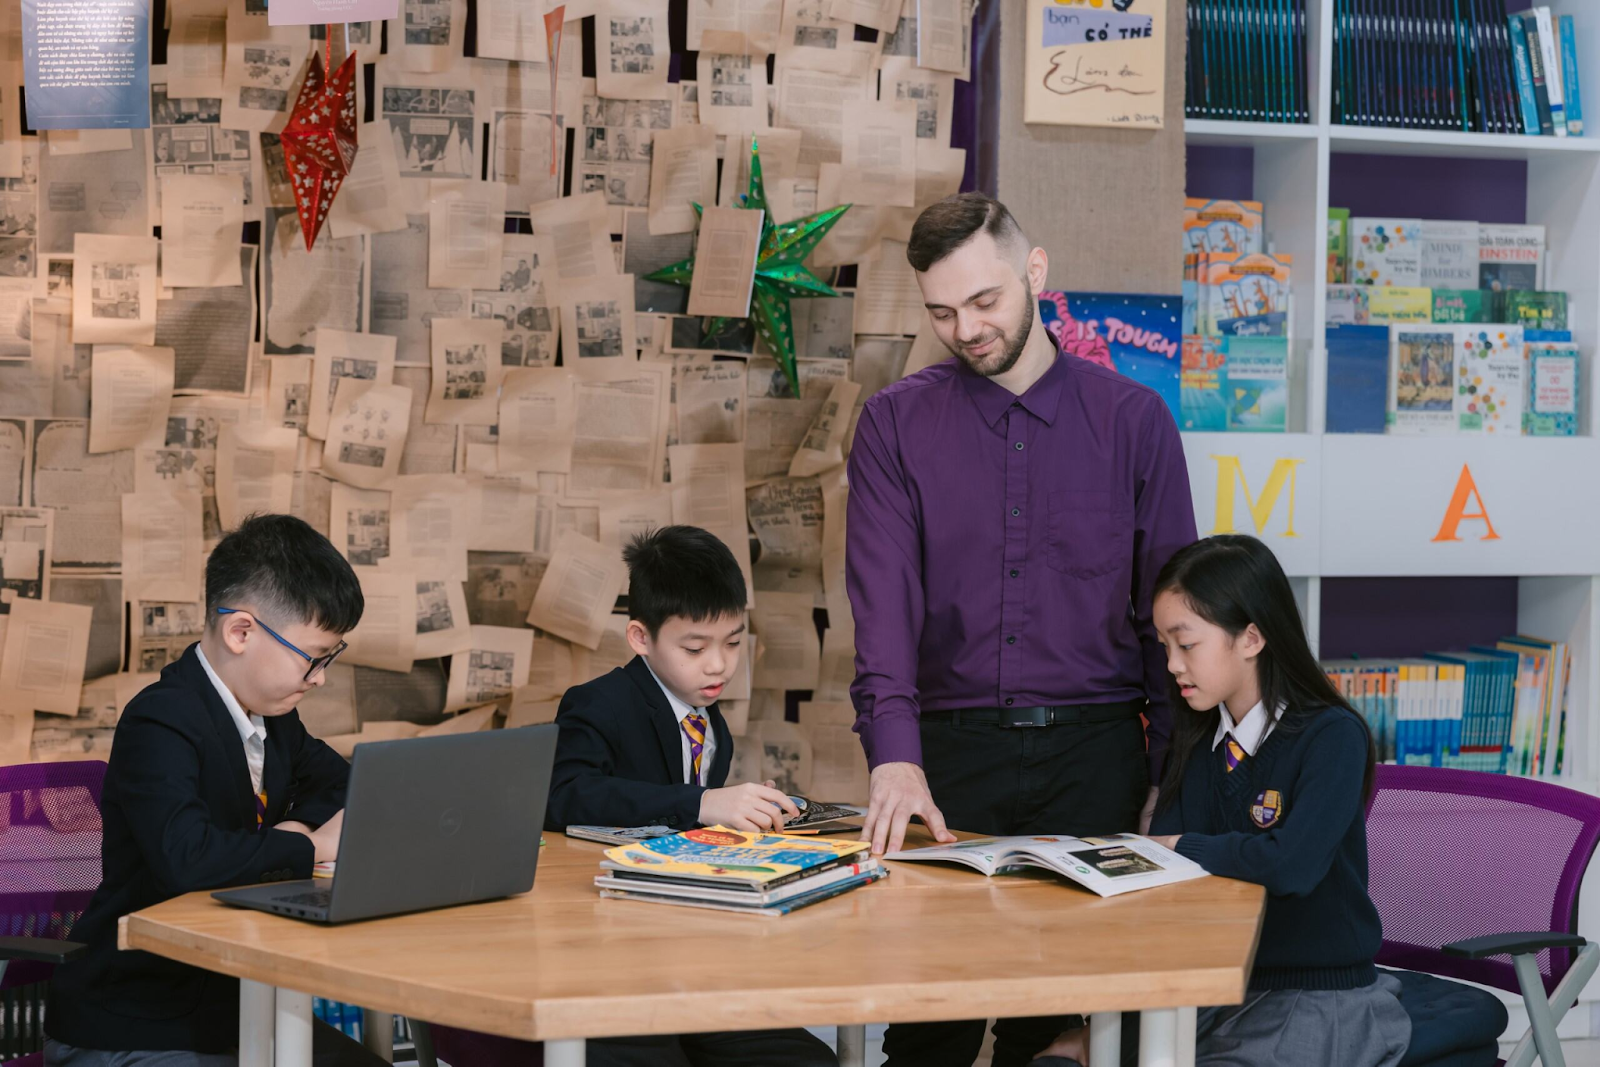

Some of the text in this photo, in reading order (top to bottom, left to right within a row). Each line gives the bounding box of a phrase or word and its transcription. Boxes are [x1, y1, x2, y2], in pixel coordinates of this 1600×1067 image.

[1048, 9, 1080, 27] bạn
[1085, 22, 1109, 41] CÓ
[1479, 249, 1538, 260] EINSTEIN
[1078, 319, 1098, 340] IS
[1105, 317, 1178, 359] TOUGH
[1204, 454, 1502, 542] M A
